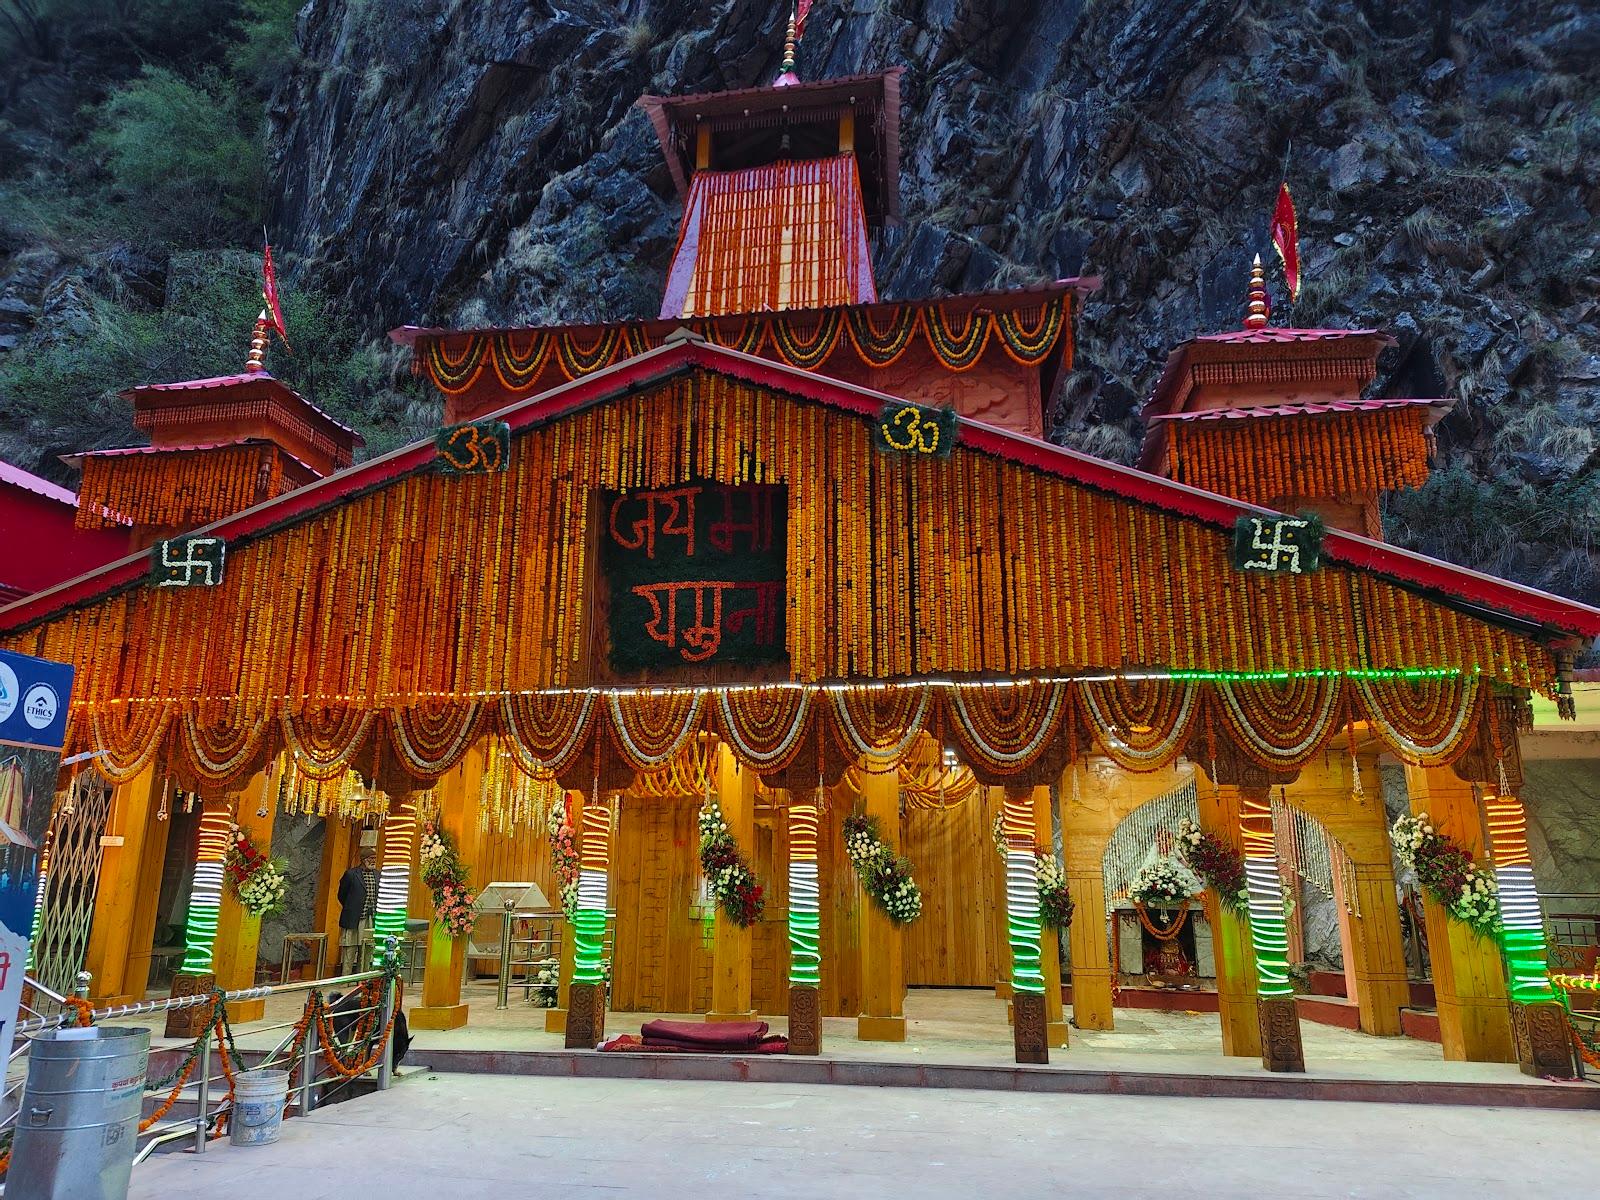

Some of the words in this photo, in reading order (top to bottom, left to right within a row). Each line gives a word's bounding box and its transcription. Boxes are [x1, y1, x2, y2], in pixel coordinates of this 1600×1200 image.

[609, 486, 703, 558] जय
[631, 581, 784, 661] यमुना
[27, 706, 53, 717] ETHICS
